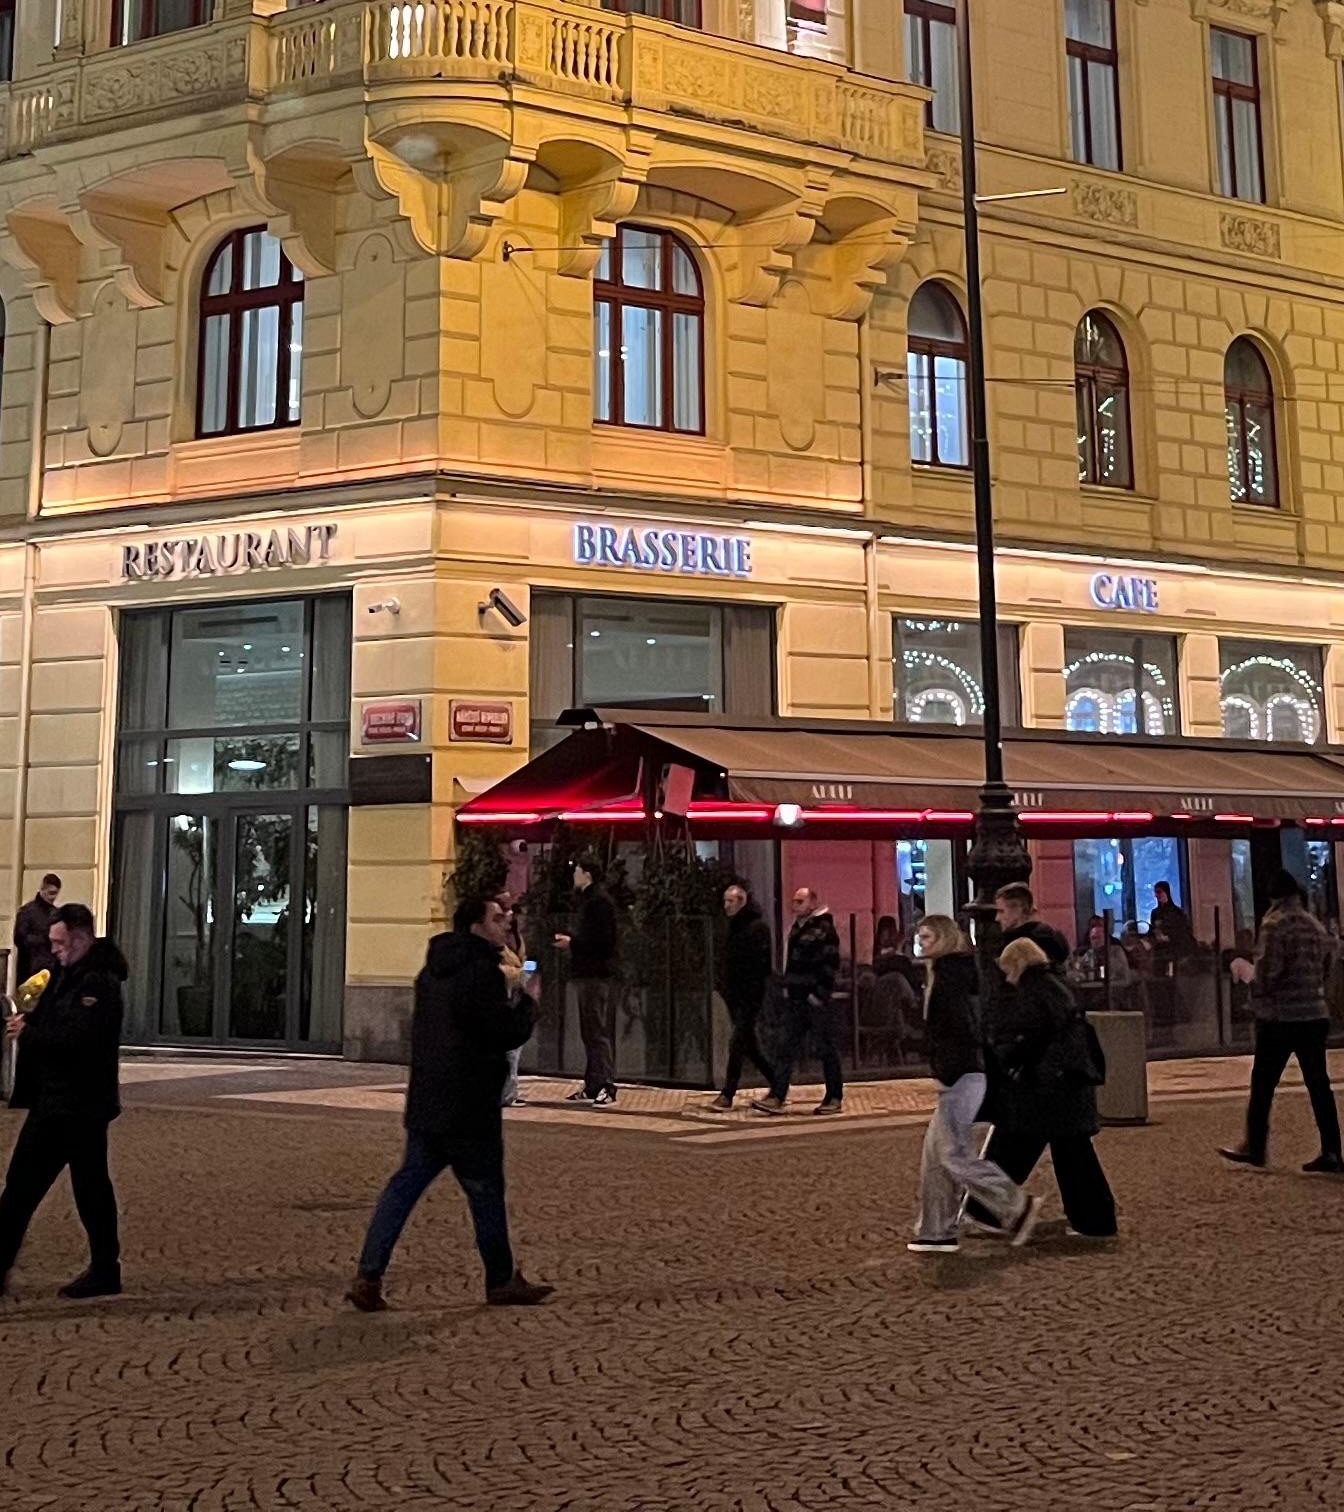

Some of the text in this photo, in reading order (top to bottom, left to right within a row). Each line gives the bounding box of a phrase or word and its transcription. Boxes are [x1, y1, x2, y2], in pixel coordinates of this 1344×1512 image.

[121, 523, 339, 578] RESTAURANT
[575, 524, 753, 578] BRASSERIE
[1091, 572, 1159, 612] CAFE
